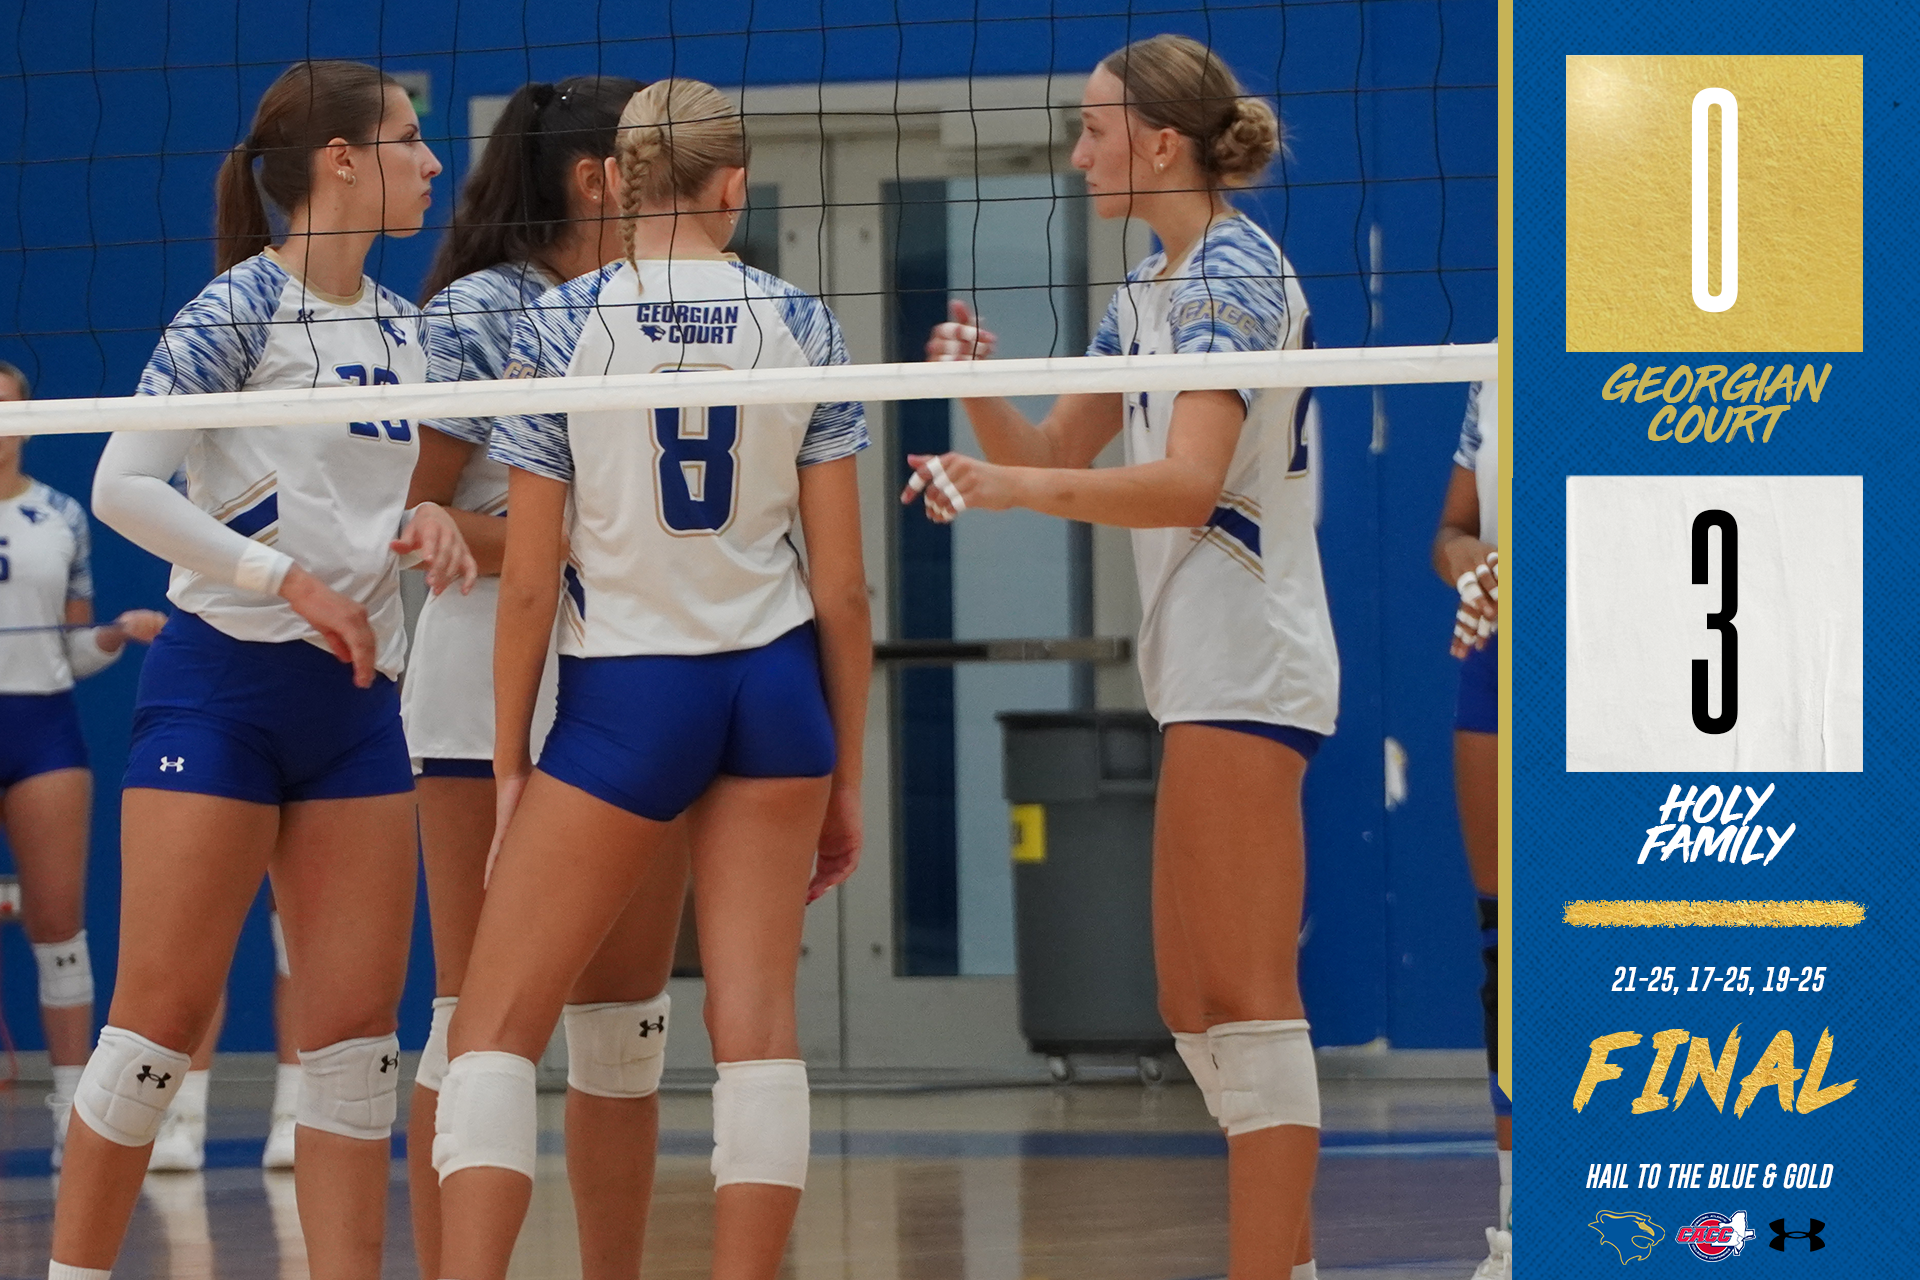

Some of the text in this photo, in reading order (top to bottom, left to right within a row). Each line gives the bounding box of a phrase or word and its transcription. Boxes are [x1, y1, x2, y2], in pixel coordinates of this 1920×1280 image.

[637, 304, 738, 324] GEORGIAN
[668, 325, 737, 344] COURT
[648, 363, 743, 537] 8
